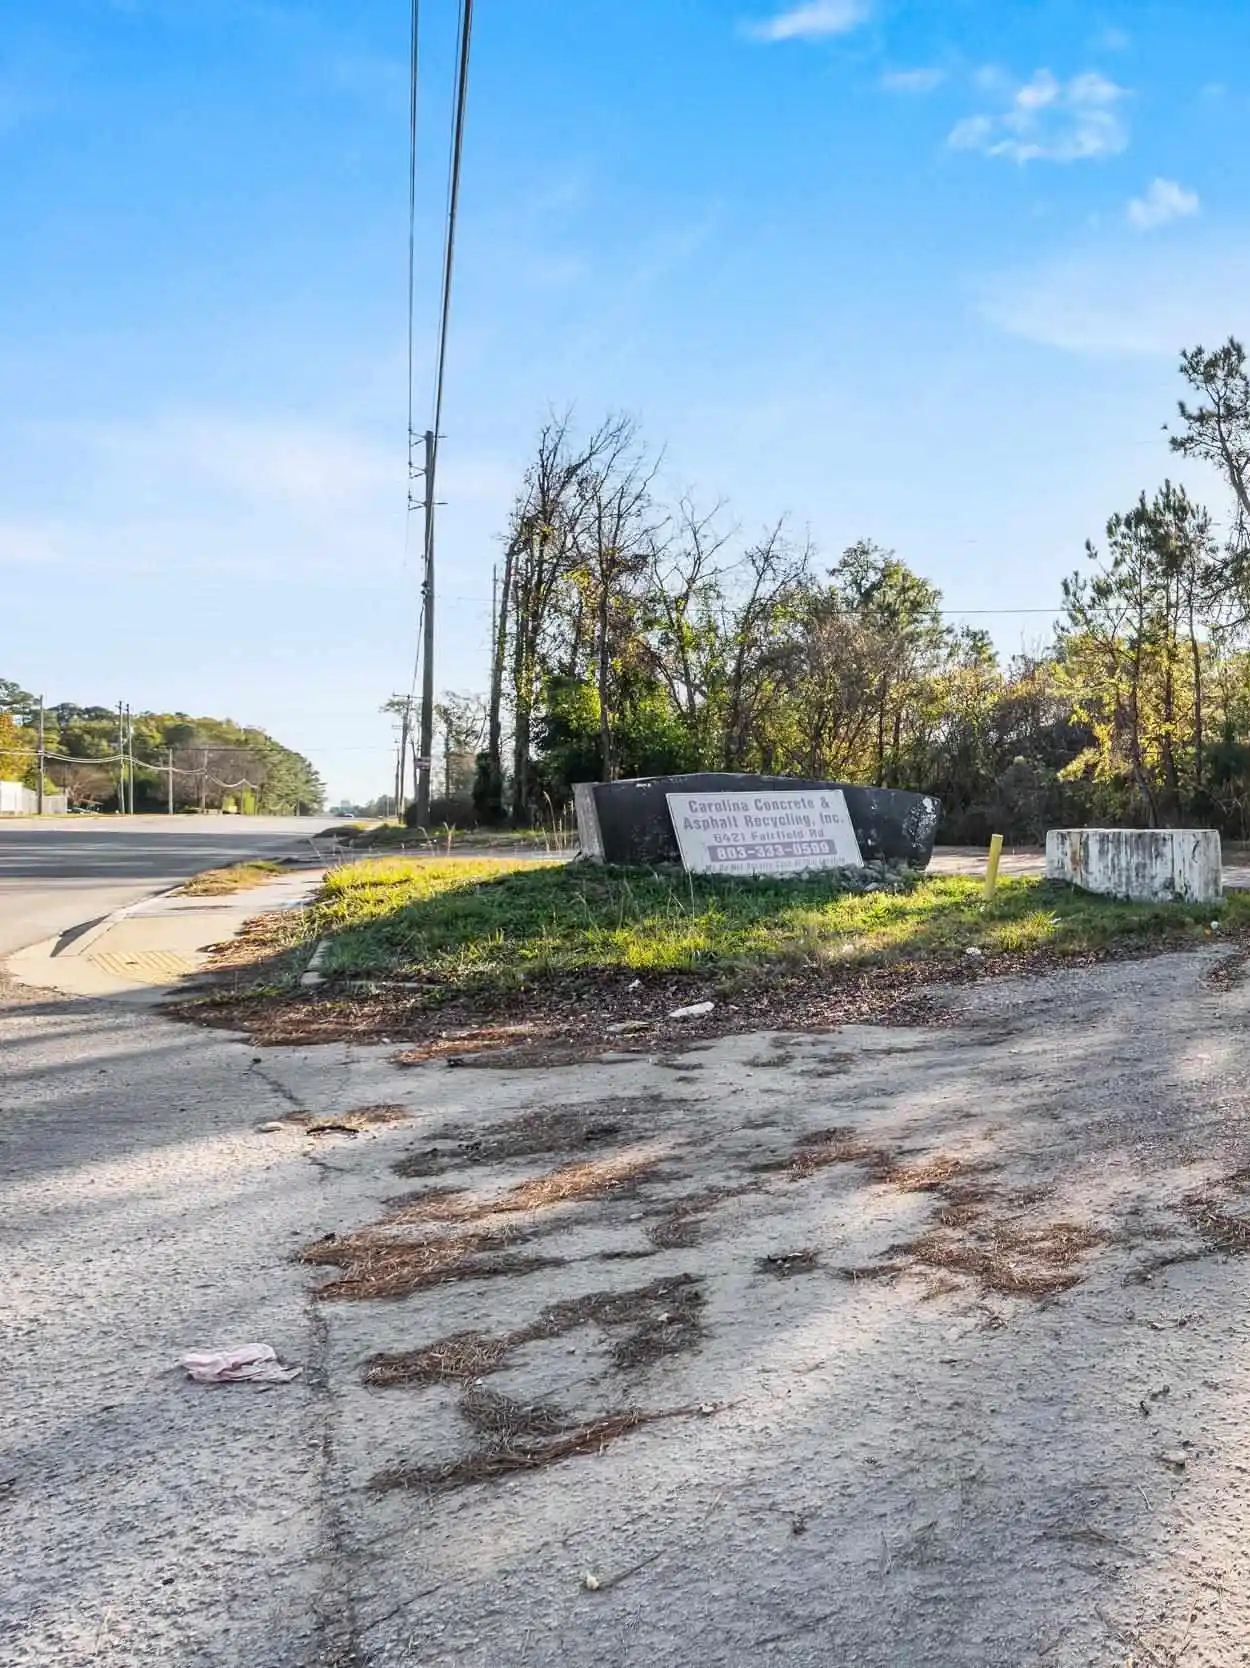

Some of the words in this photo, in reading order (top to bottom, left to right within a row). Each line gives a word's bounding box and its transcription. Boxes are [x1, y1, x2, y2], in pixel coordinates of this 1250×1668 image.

[688, 799, 749, 814] Carolina
[754, 797, 815, 812] Concrete
[819, 796, 831, 808] &
[683, 815, 739, 831] Asphalt
[744, 813, 816, 828] Recycling,
[819, 812, 845, 825] Inc.
